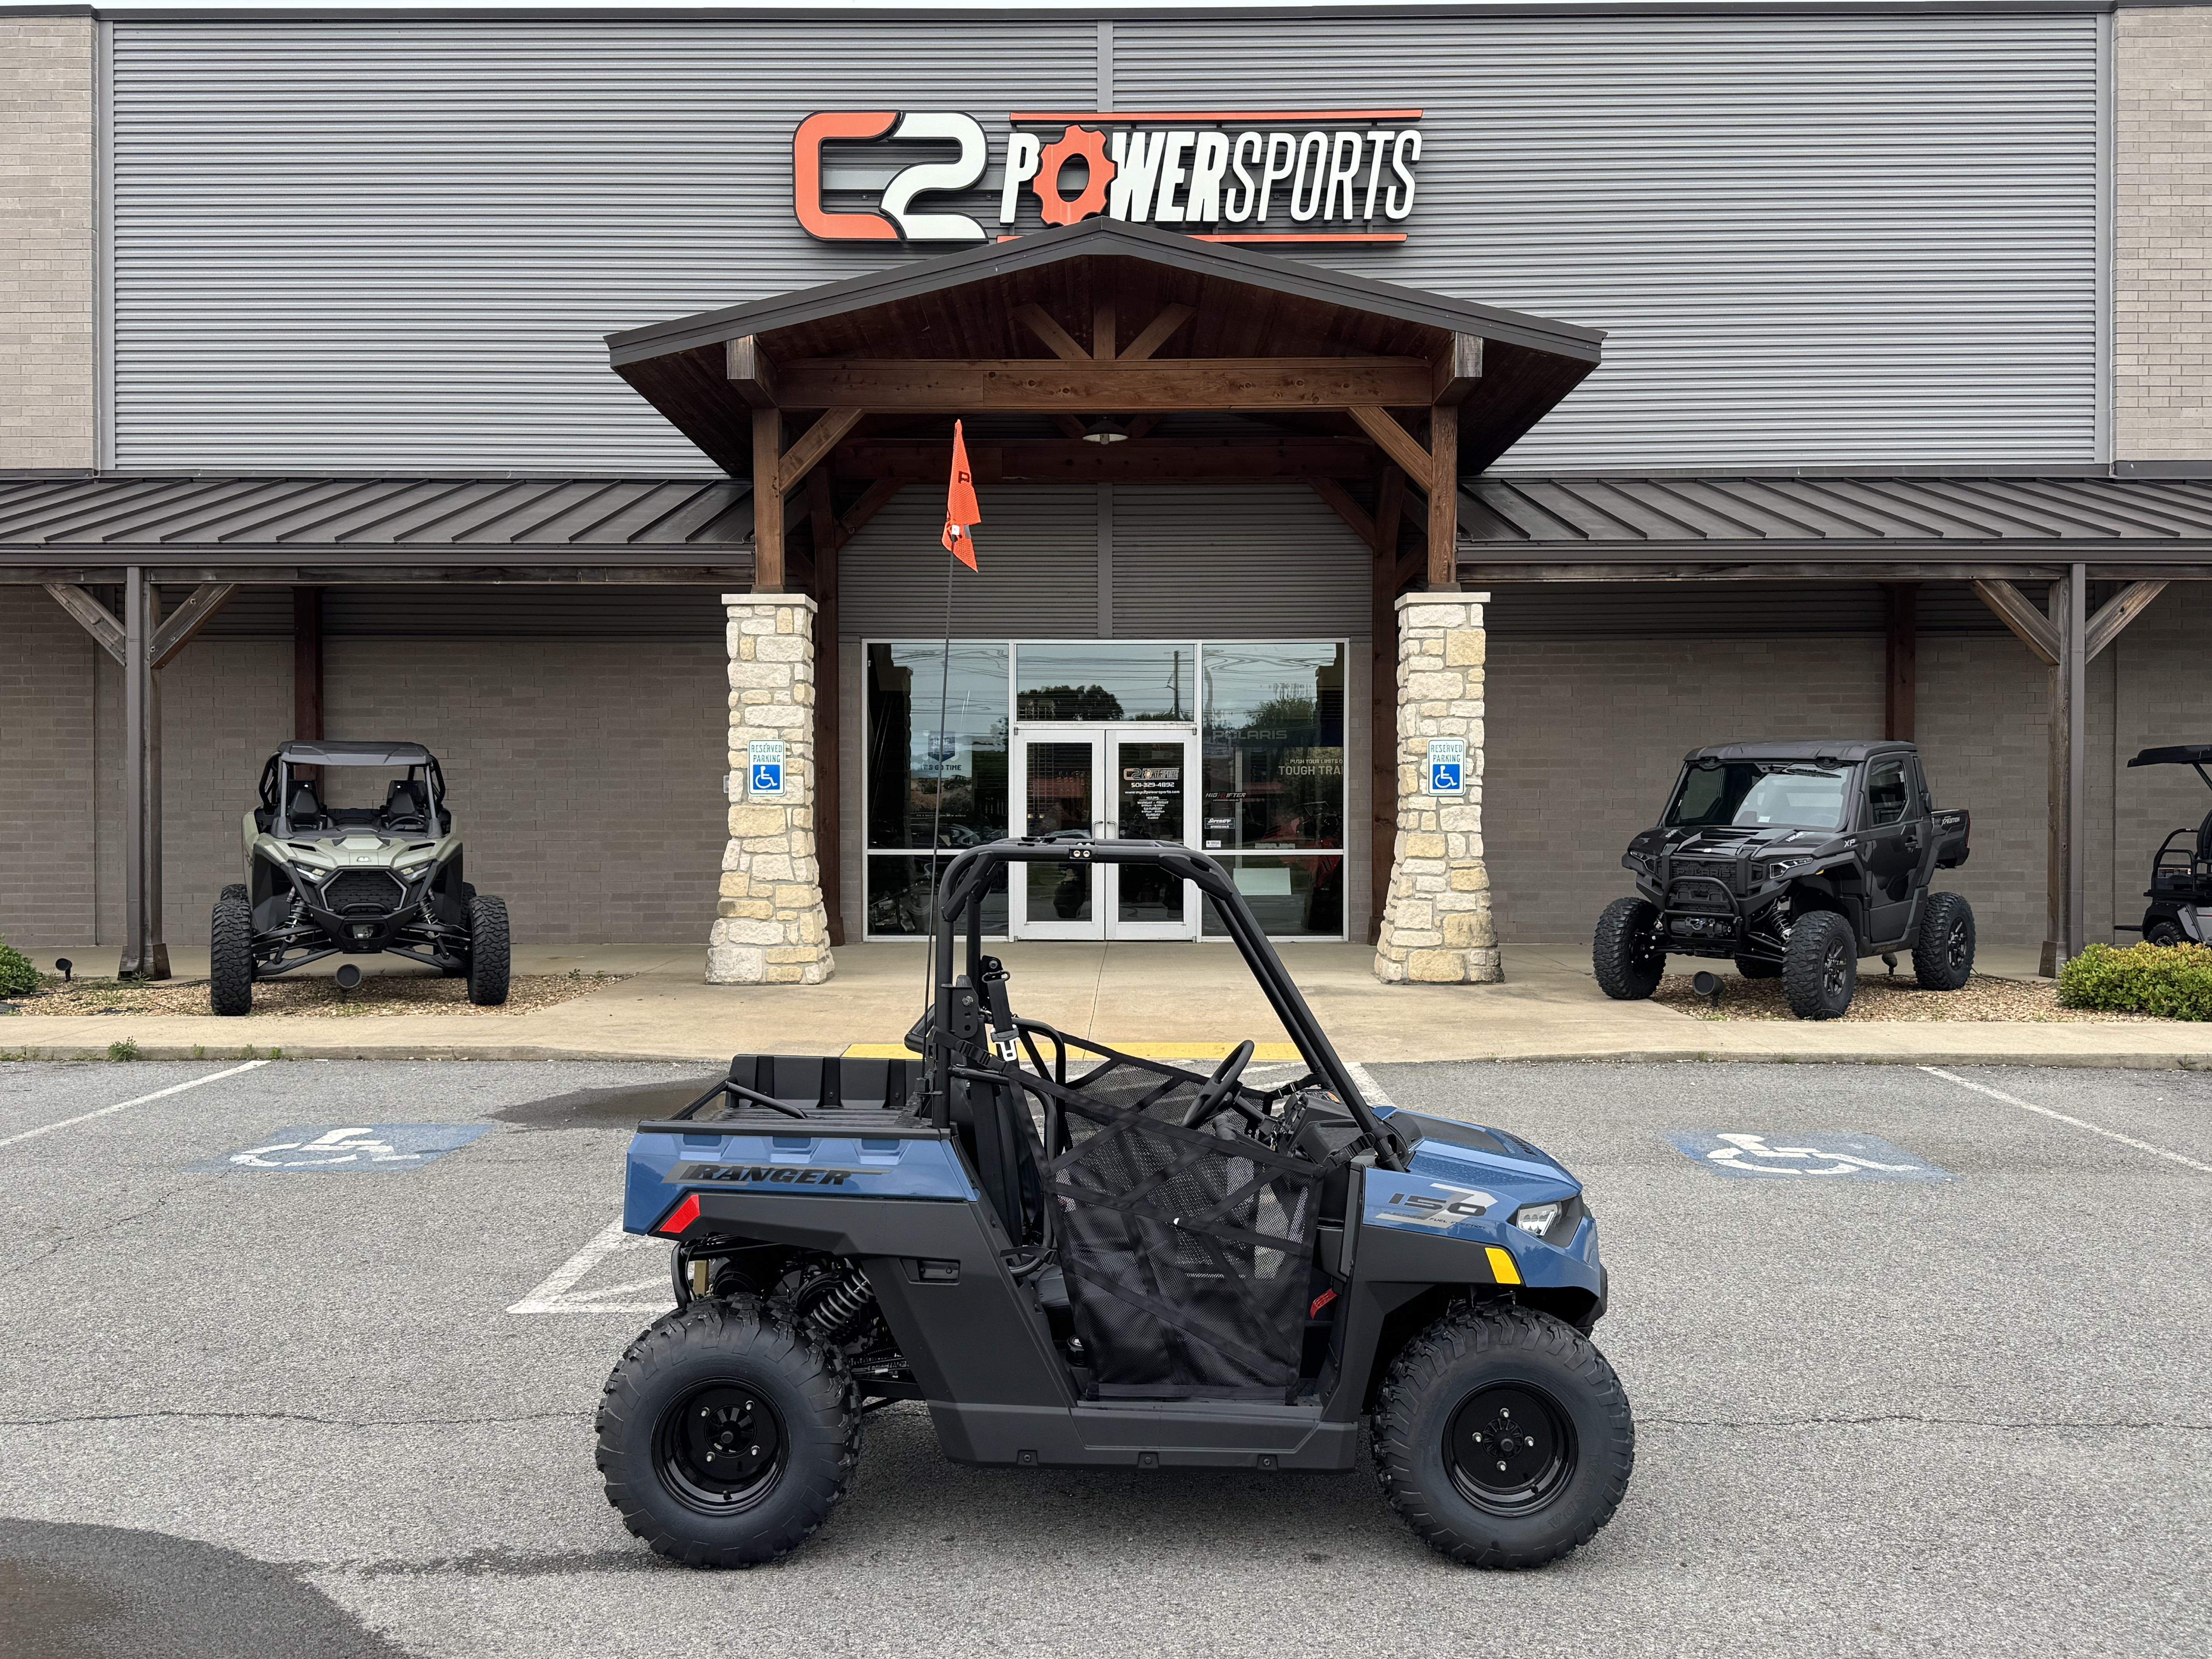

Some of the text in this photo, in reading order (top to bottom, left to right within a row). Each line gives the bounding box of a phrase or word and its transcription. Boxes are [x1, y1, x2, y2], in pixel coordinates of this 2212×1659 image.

[794, 112, 1422, 239] C2 POWERSPORTS
[1212, 730, 1287, 739] POLARIS
[1431, 744, 1462, 752] RESERVED
[1433, 754, 1460, 763] PARKING
[1278, 766, 1315, 775] TOUGH
[1844, 838, 1856, 848] XP
[1677, 868, 1731, 877] POLARIS
[686, 1164, 852, 1185] RANGER
[1388, 1193, 1487, 1217] 150
[1547, 1453, 1600, 1529] WANDA
